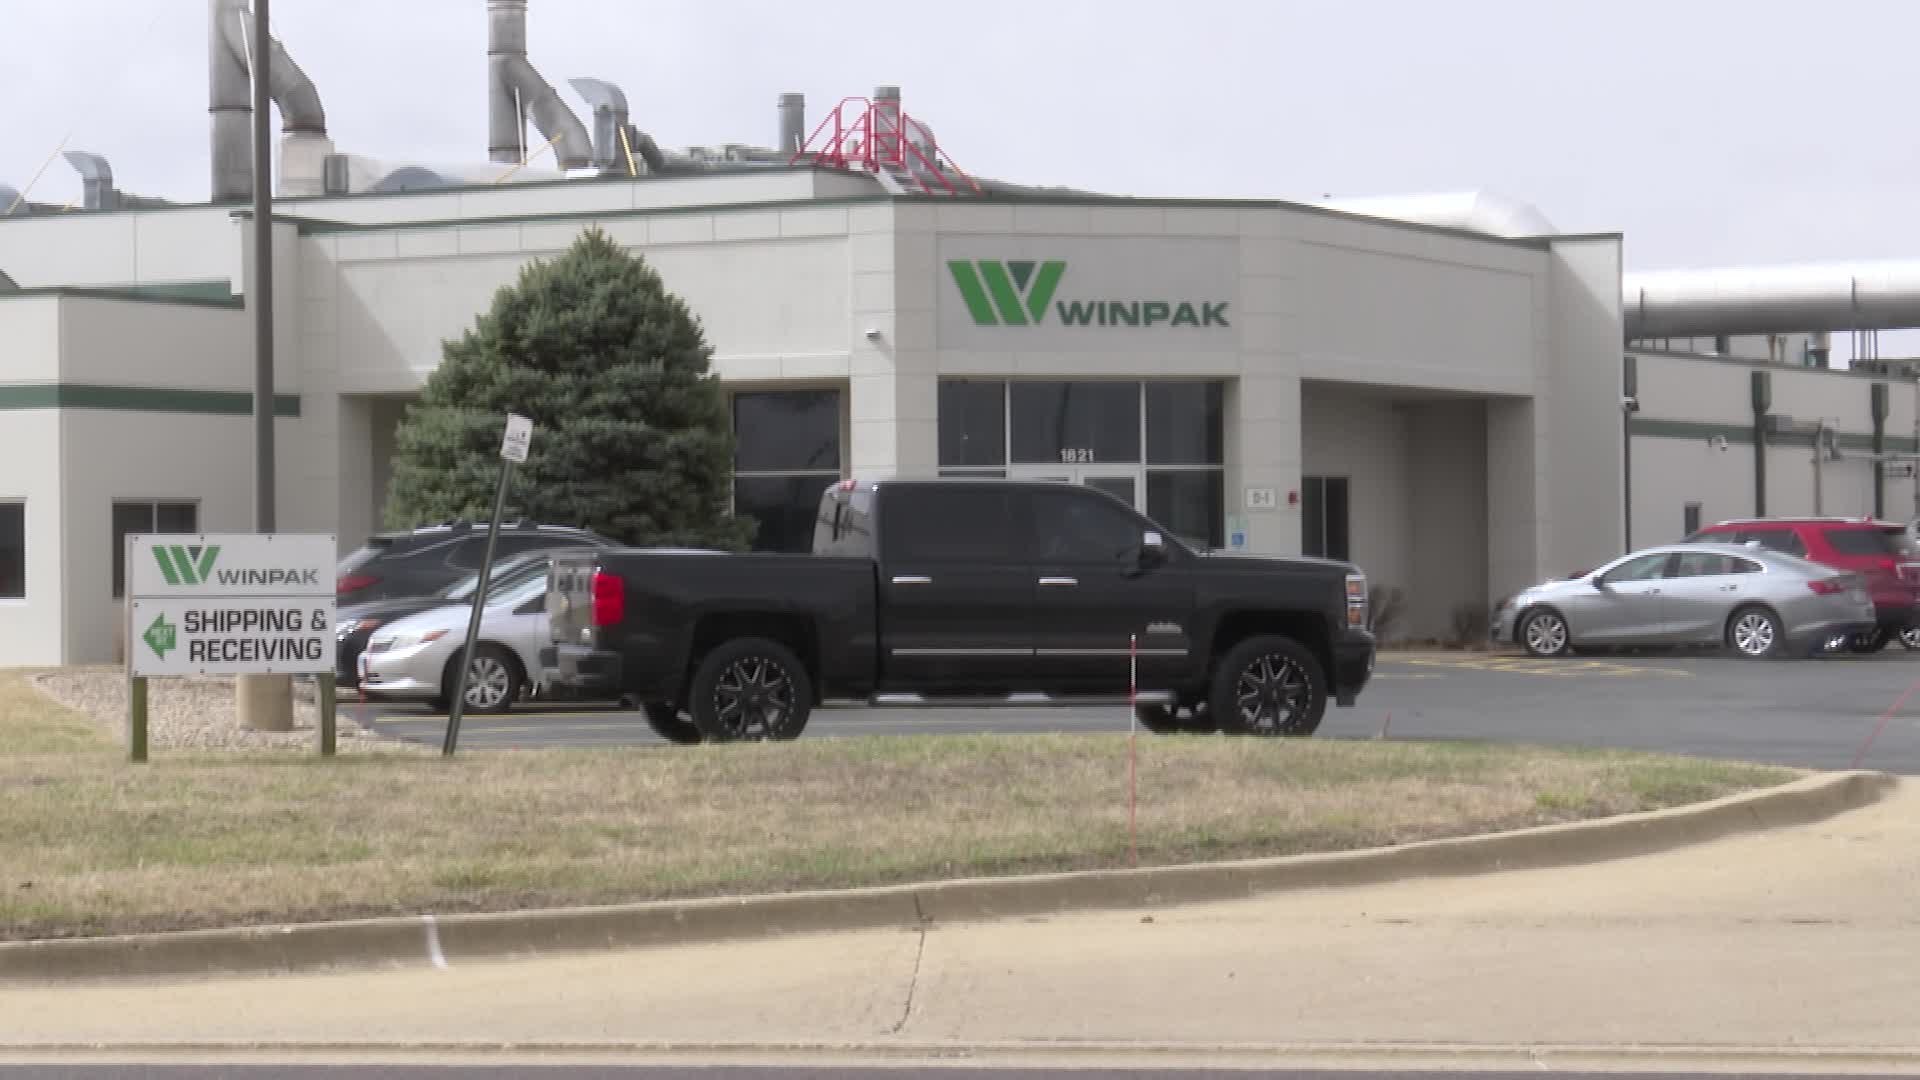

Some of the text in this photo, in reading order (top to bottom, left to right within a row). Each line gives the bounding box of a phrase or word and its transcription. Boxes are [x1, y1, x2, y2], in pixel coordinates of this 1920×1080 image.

[1056, 300, 1230, 327] WINPAK
[1061, 448, 1094, 462] 1821
[217, 568, 319, 585] WINPAK
[184, 608, 302, 633] SHIPPING
[311, 608, 327, 630] &
[189, 637, 322, 662] RECEIVING
